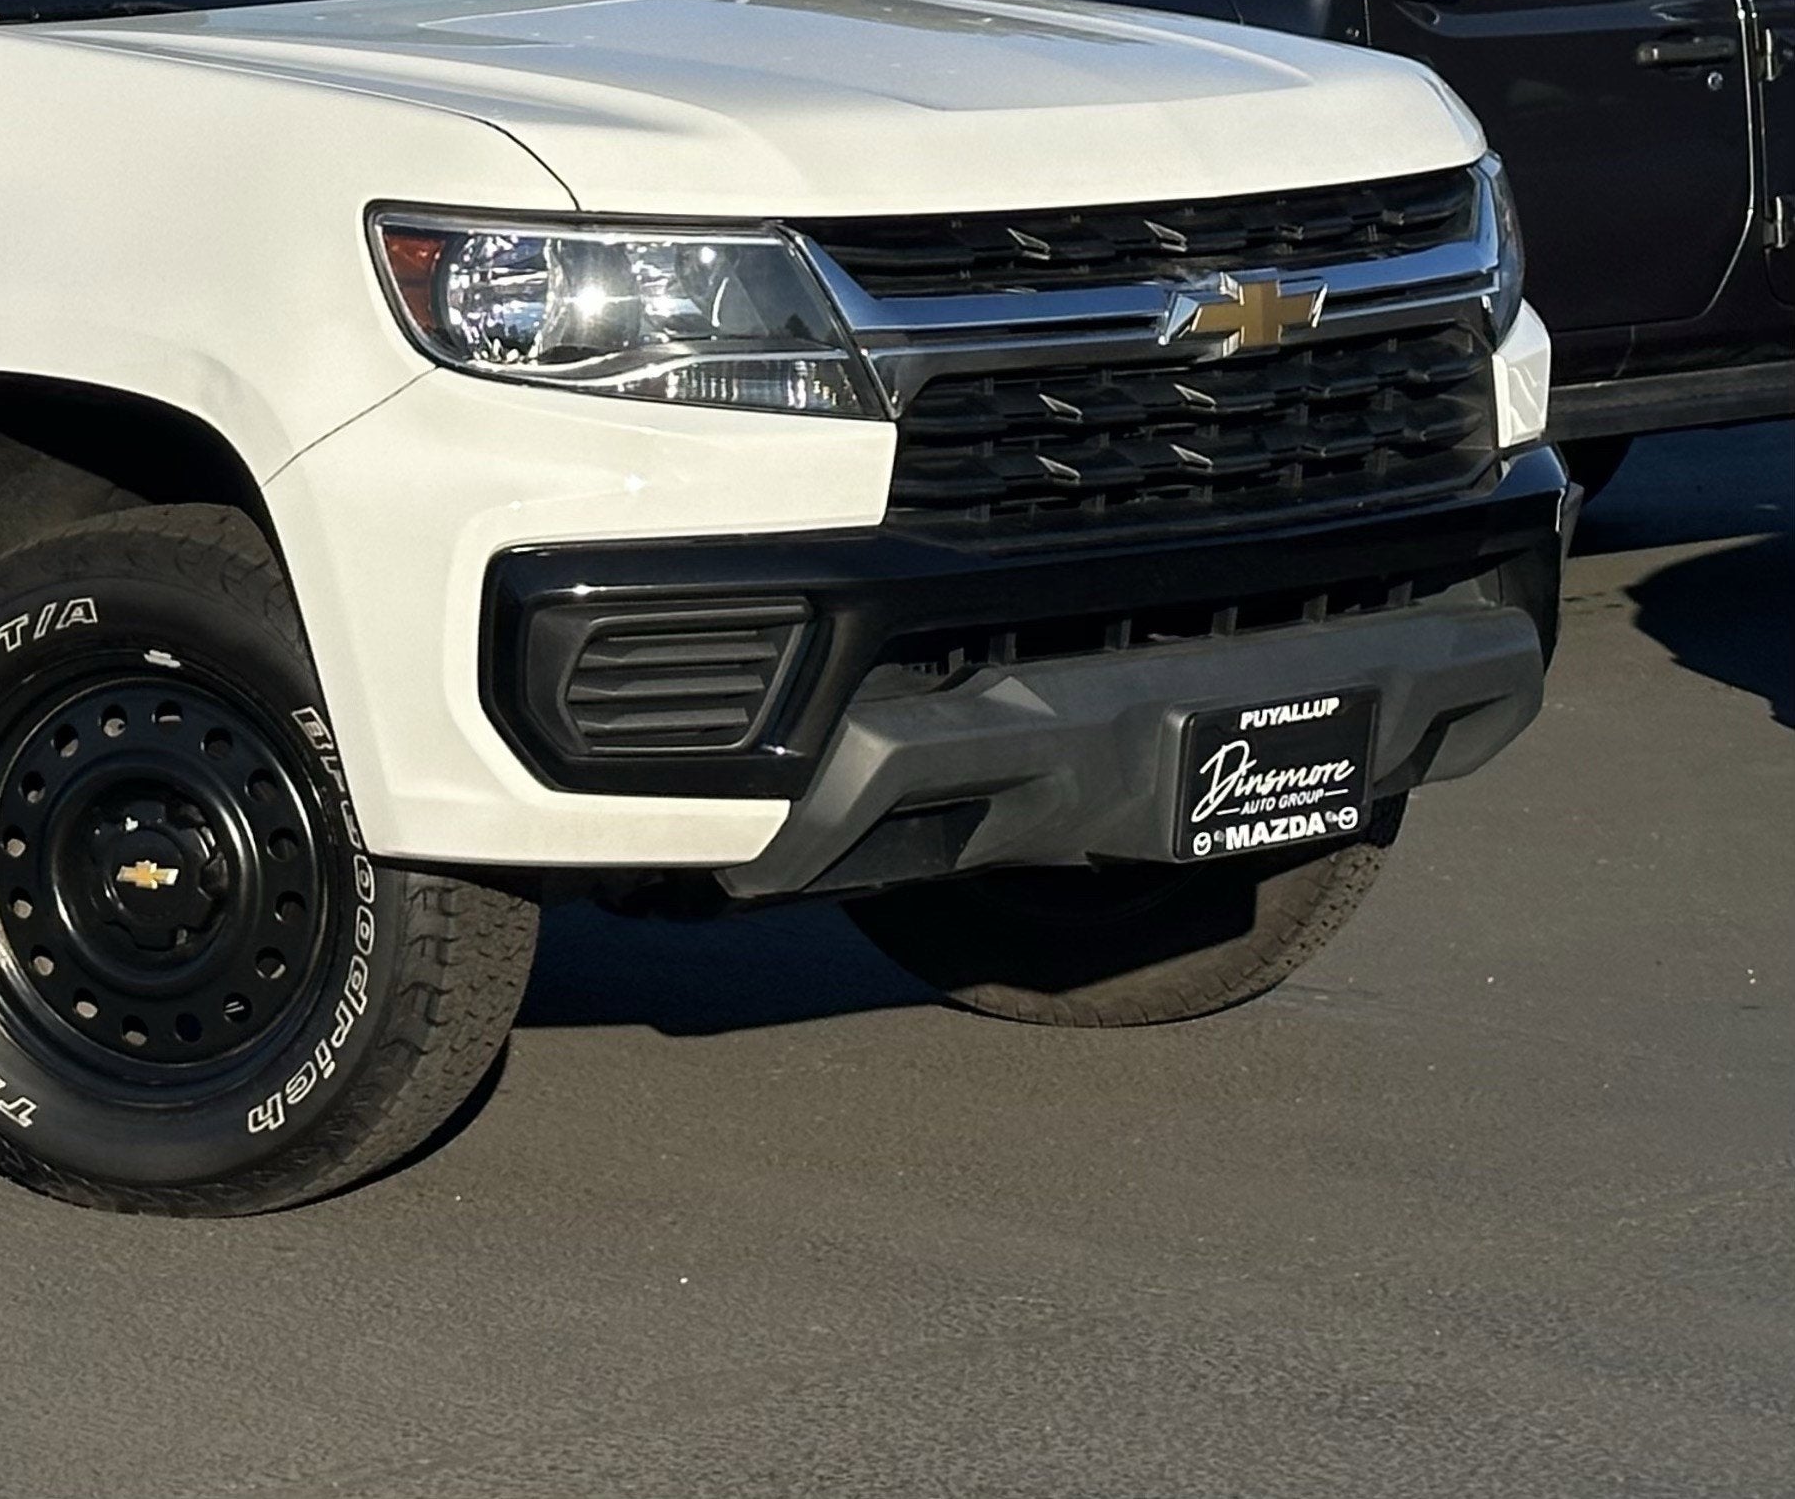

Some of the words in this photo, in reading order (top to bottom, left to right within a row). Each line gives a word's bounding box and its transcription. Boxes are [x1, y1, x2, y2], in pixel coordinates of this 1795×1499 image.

[1240, 697, 1340, 731] PUYALLUP
[1191, 740, 1355, 823] Dinsmore
[1240, 796, 1275, 815] AUTO
[1278, 788, 1324, 809] GROUP
[1225, 812, 1326, 850] MAZDA
